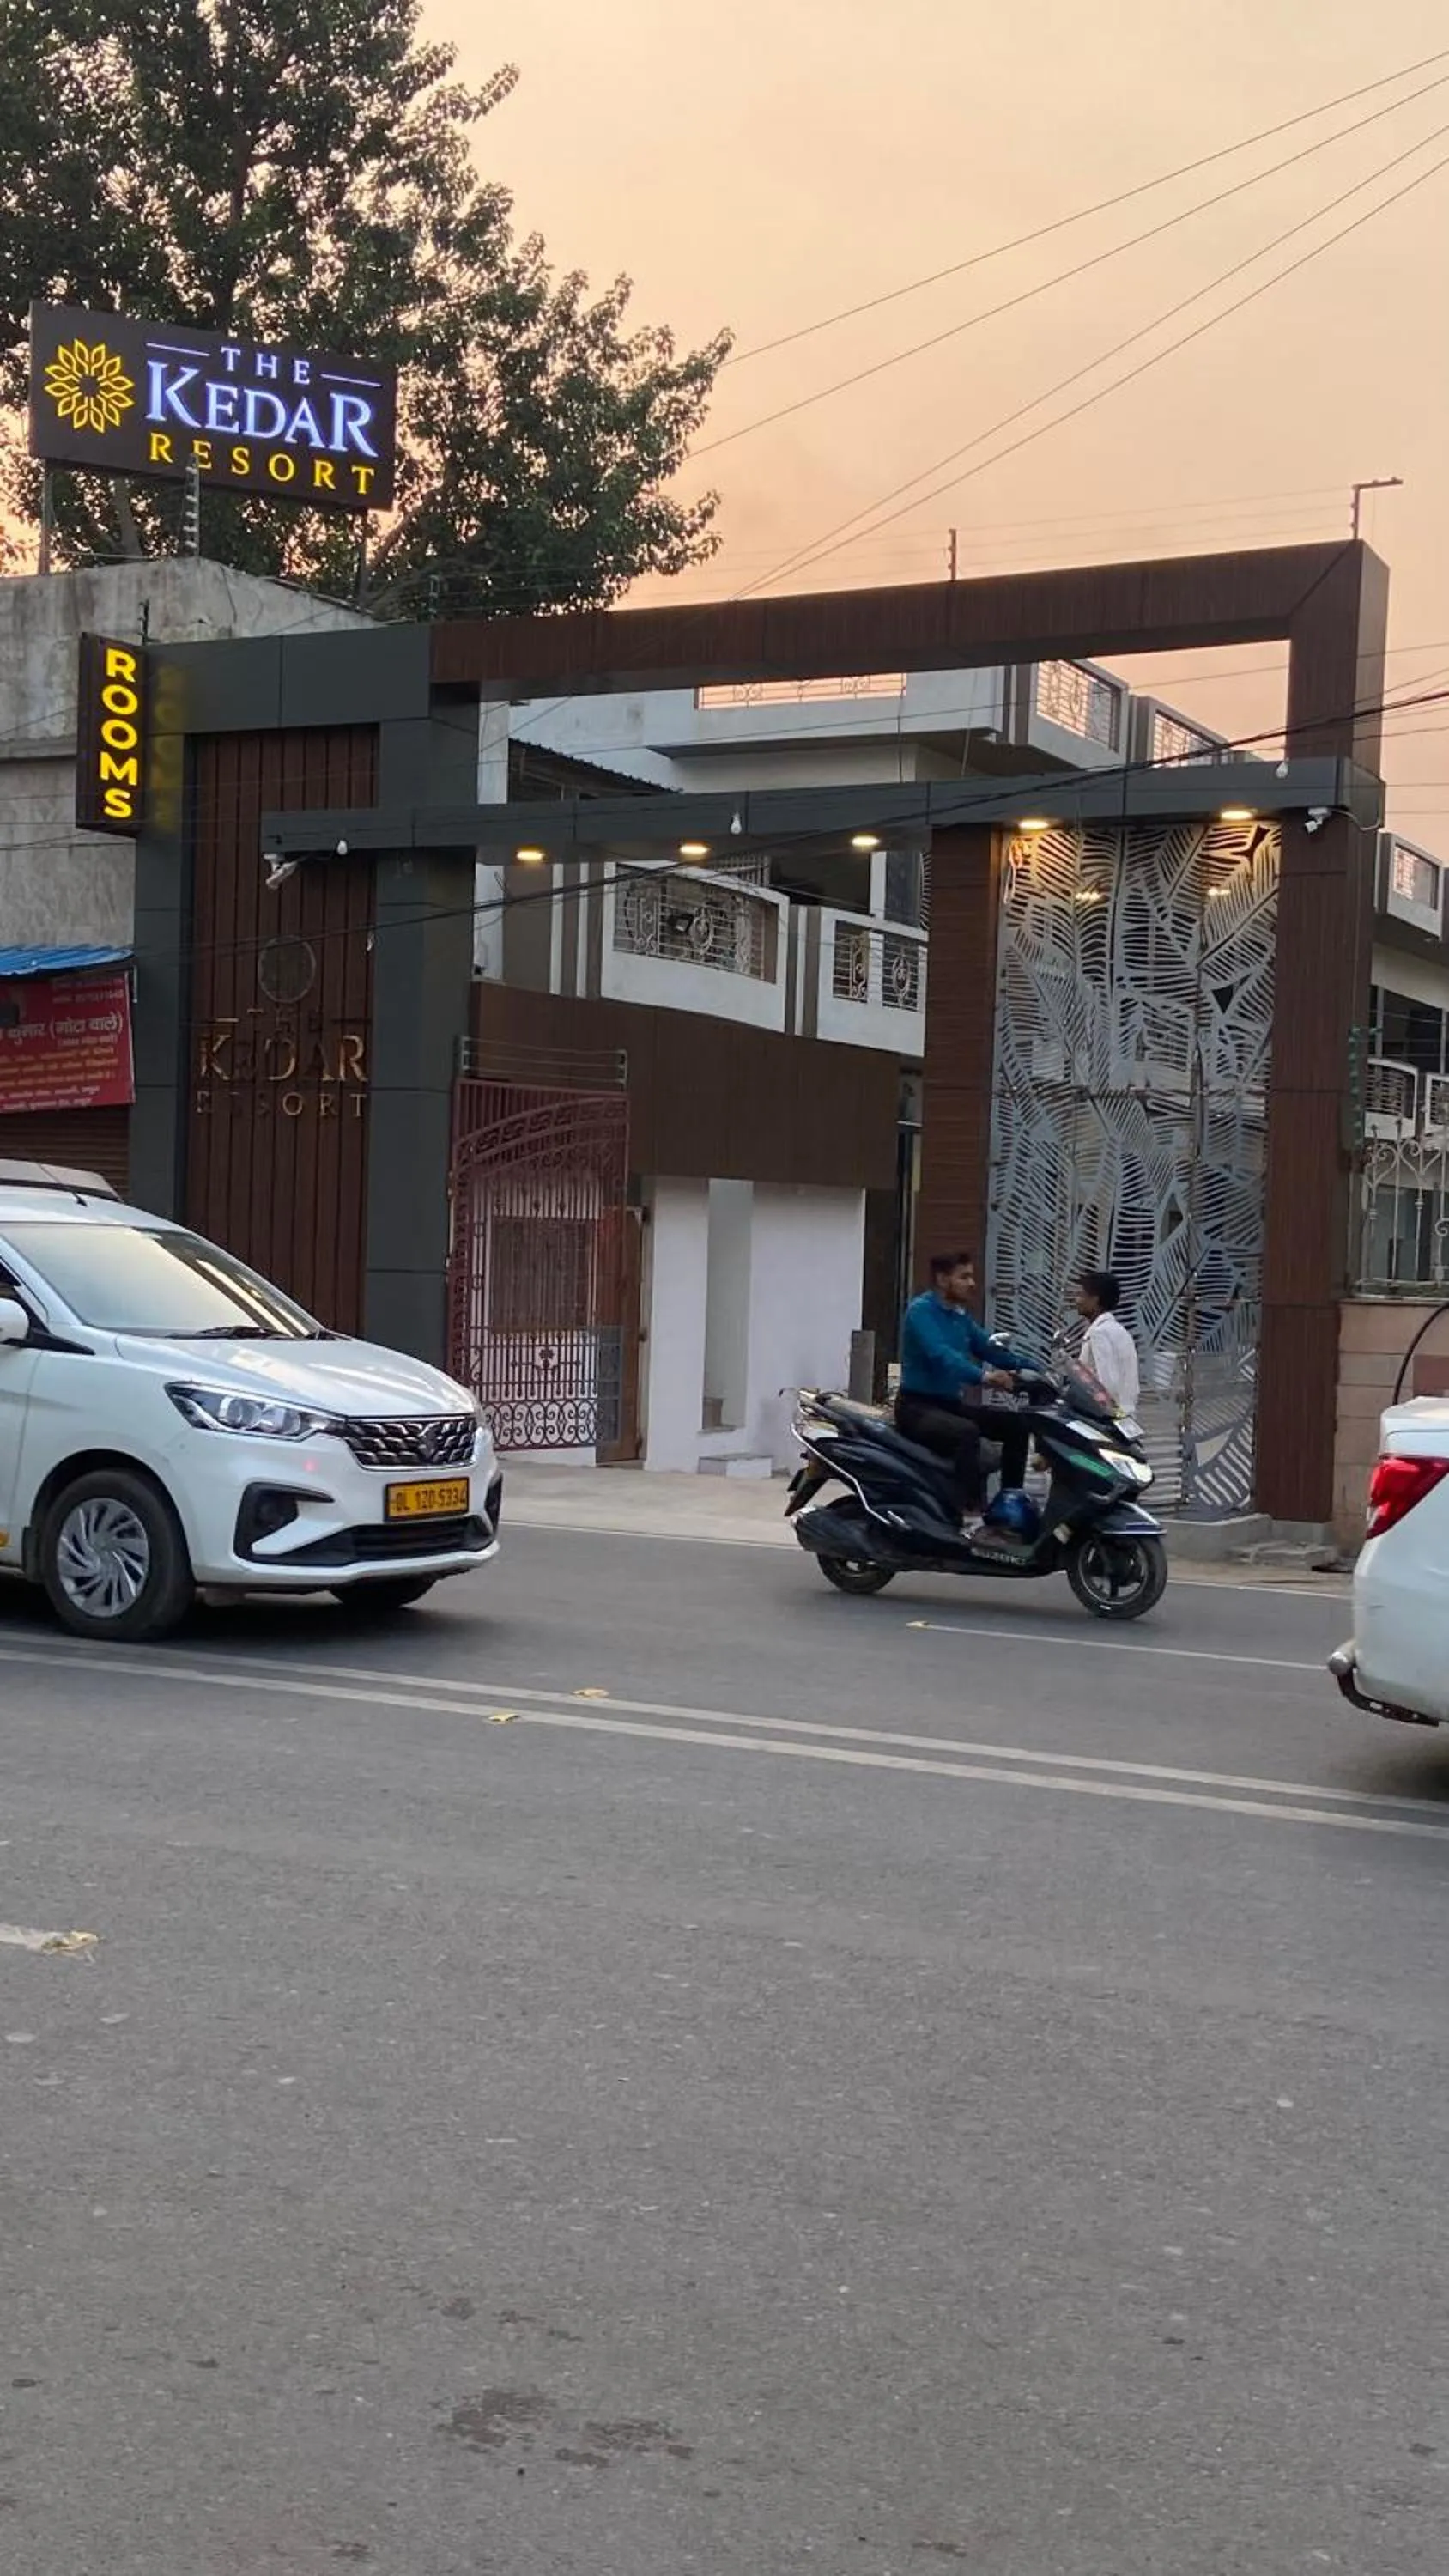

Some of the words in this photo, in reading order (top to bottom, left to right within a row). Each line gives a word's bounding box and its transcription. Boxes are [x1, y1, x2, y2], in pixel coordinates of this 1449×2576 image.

[220, 345, 311, 386] THE
[144, 359, 379, 458] KEDAR
[149, 432, 376, 495] RESORT
[100, 647, 139, 818] ROOMS
[196, 1090, 368, 1117] RSORT
